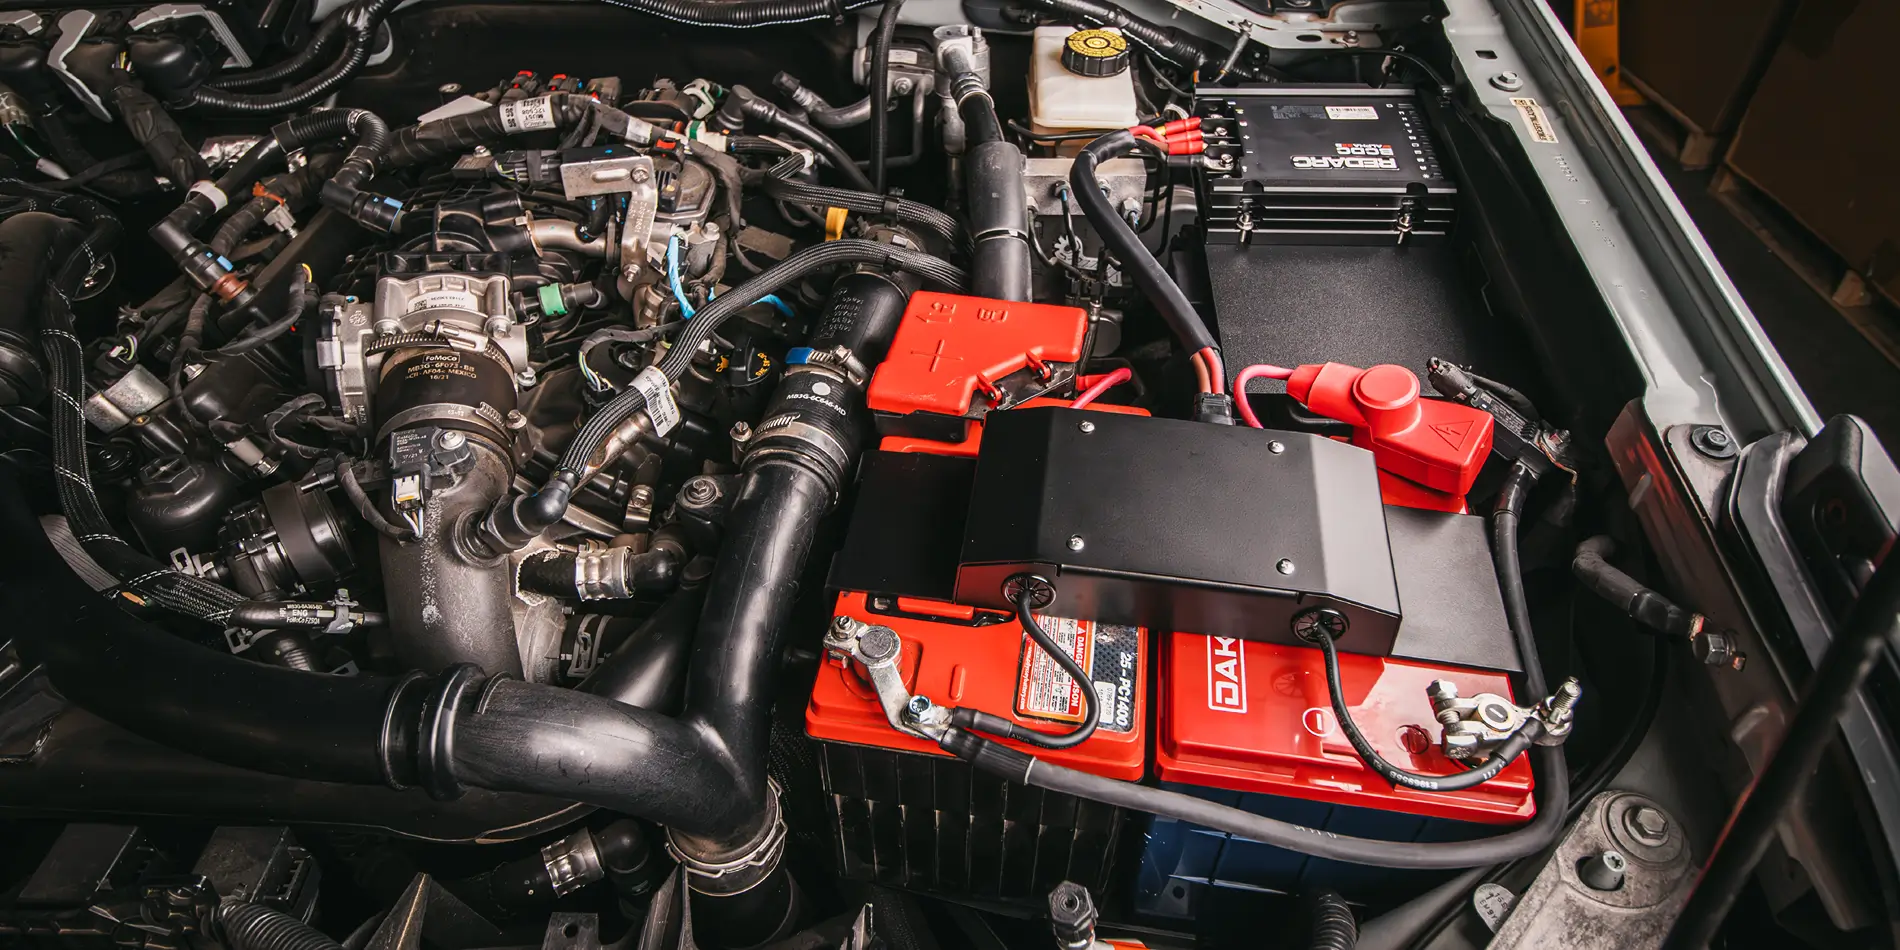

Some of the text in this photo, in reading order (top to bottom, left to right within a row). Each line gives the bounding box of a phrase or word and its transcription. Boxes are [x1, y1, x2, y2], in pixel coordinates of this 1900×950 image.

[1336, 148, 1394, 156] BCDC
[1292, 156, 1398, 169] REDARC
[448, 368, 477, 379] MEXICO
[292, 609, 309, 617] ENG
[1074, 636, 1085, 668] DANGE
[1116, 651, 1132, 727] 25-PC1400
